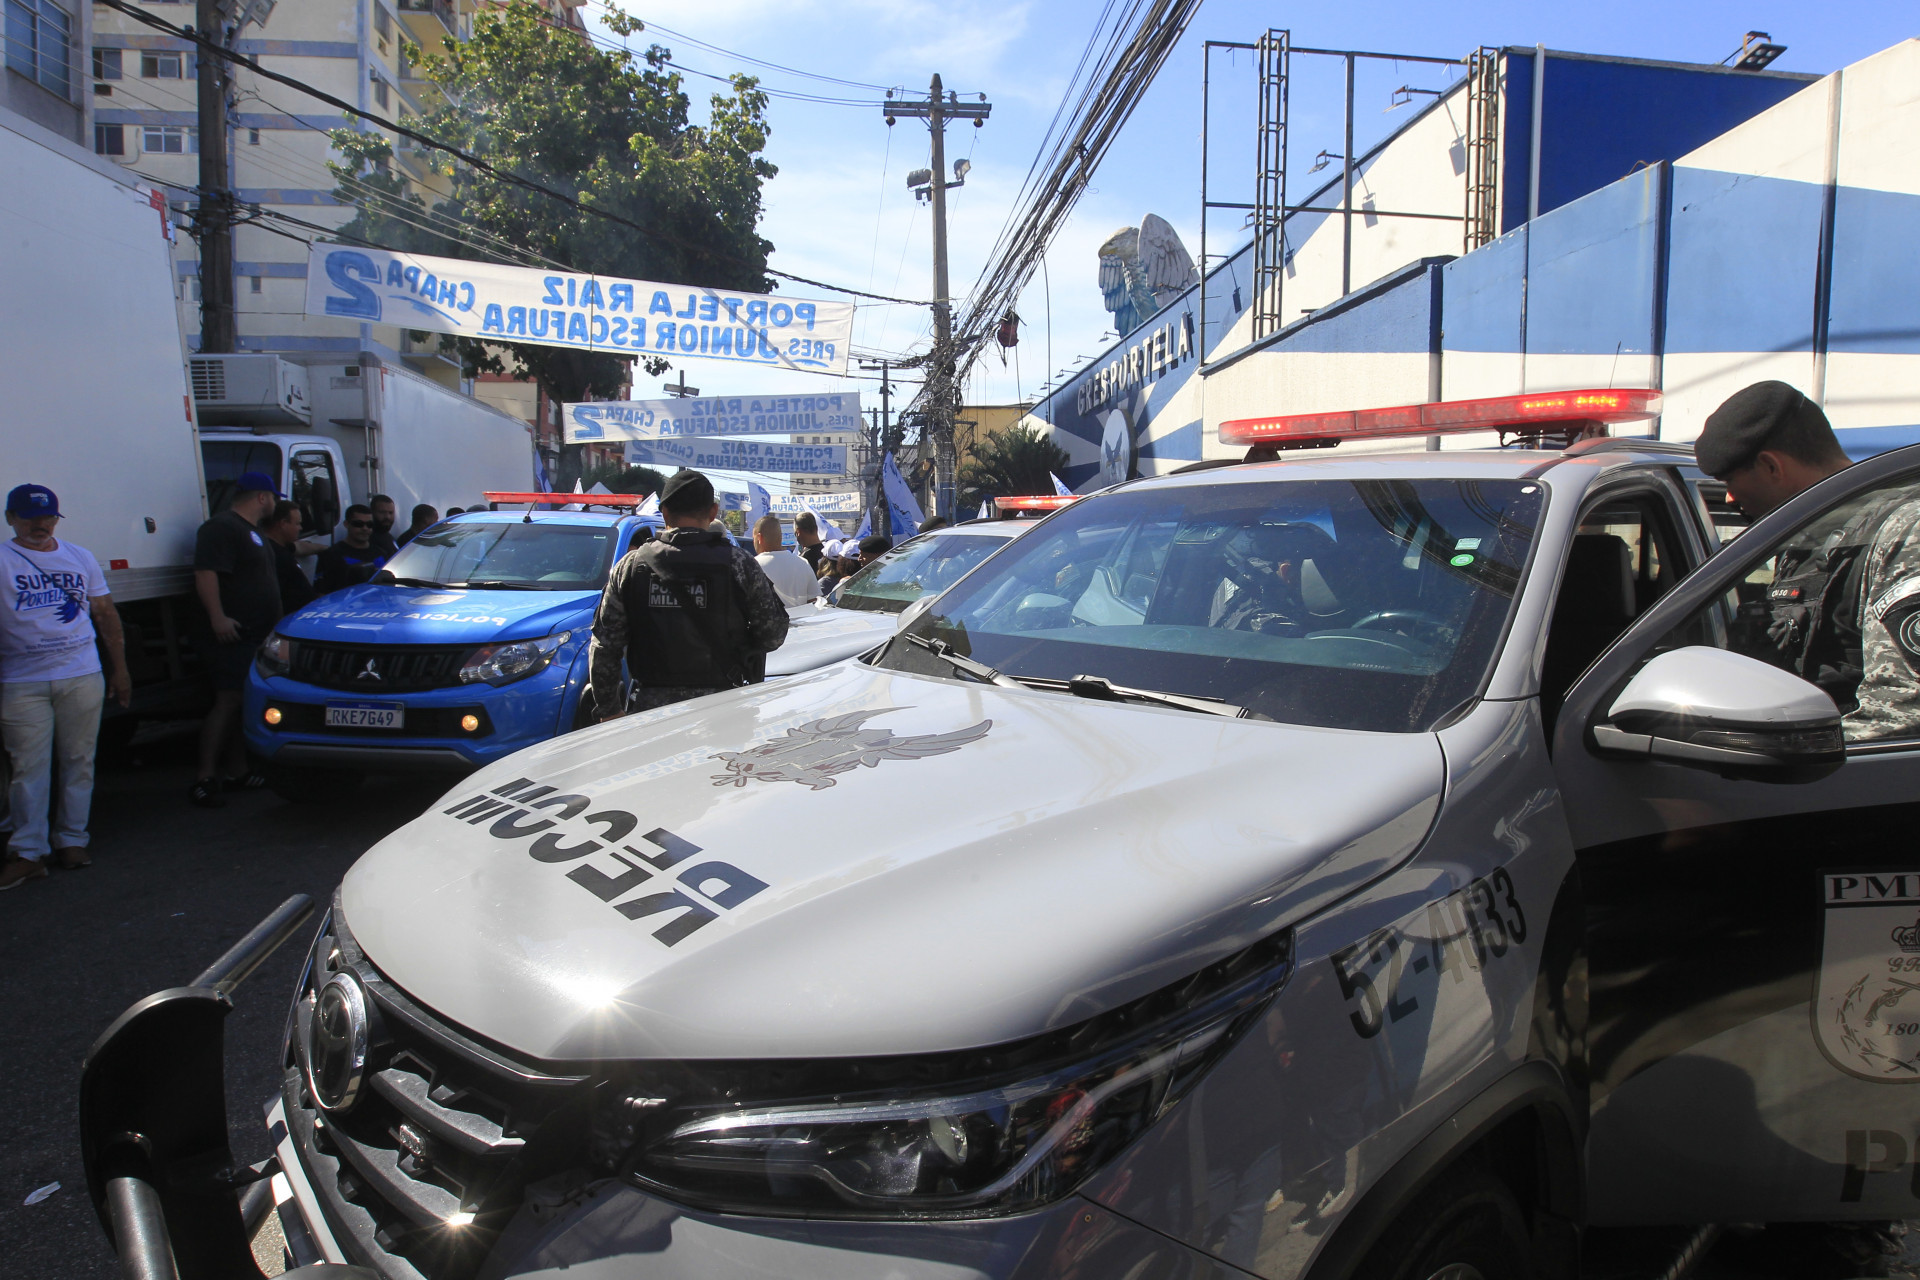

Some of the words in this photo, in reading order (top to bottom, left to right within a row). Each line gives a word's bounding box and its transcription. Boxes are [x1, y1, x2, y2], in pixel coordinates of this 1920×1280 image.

[16, 573, 85, 590] SUPERA
[332, 709, 394, 726] RKE7G49
[1883, 1022, 1920, 1036] 180
